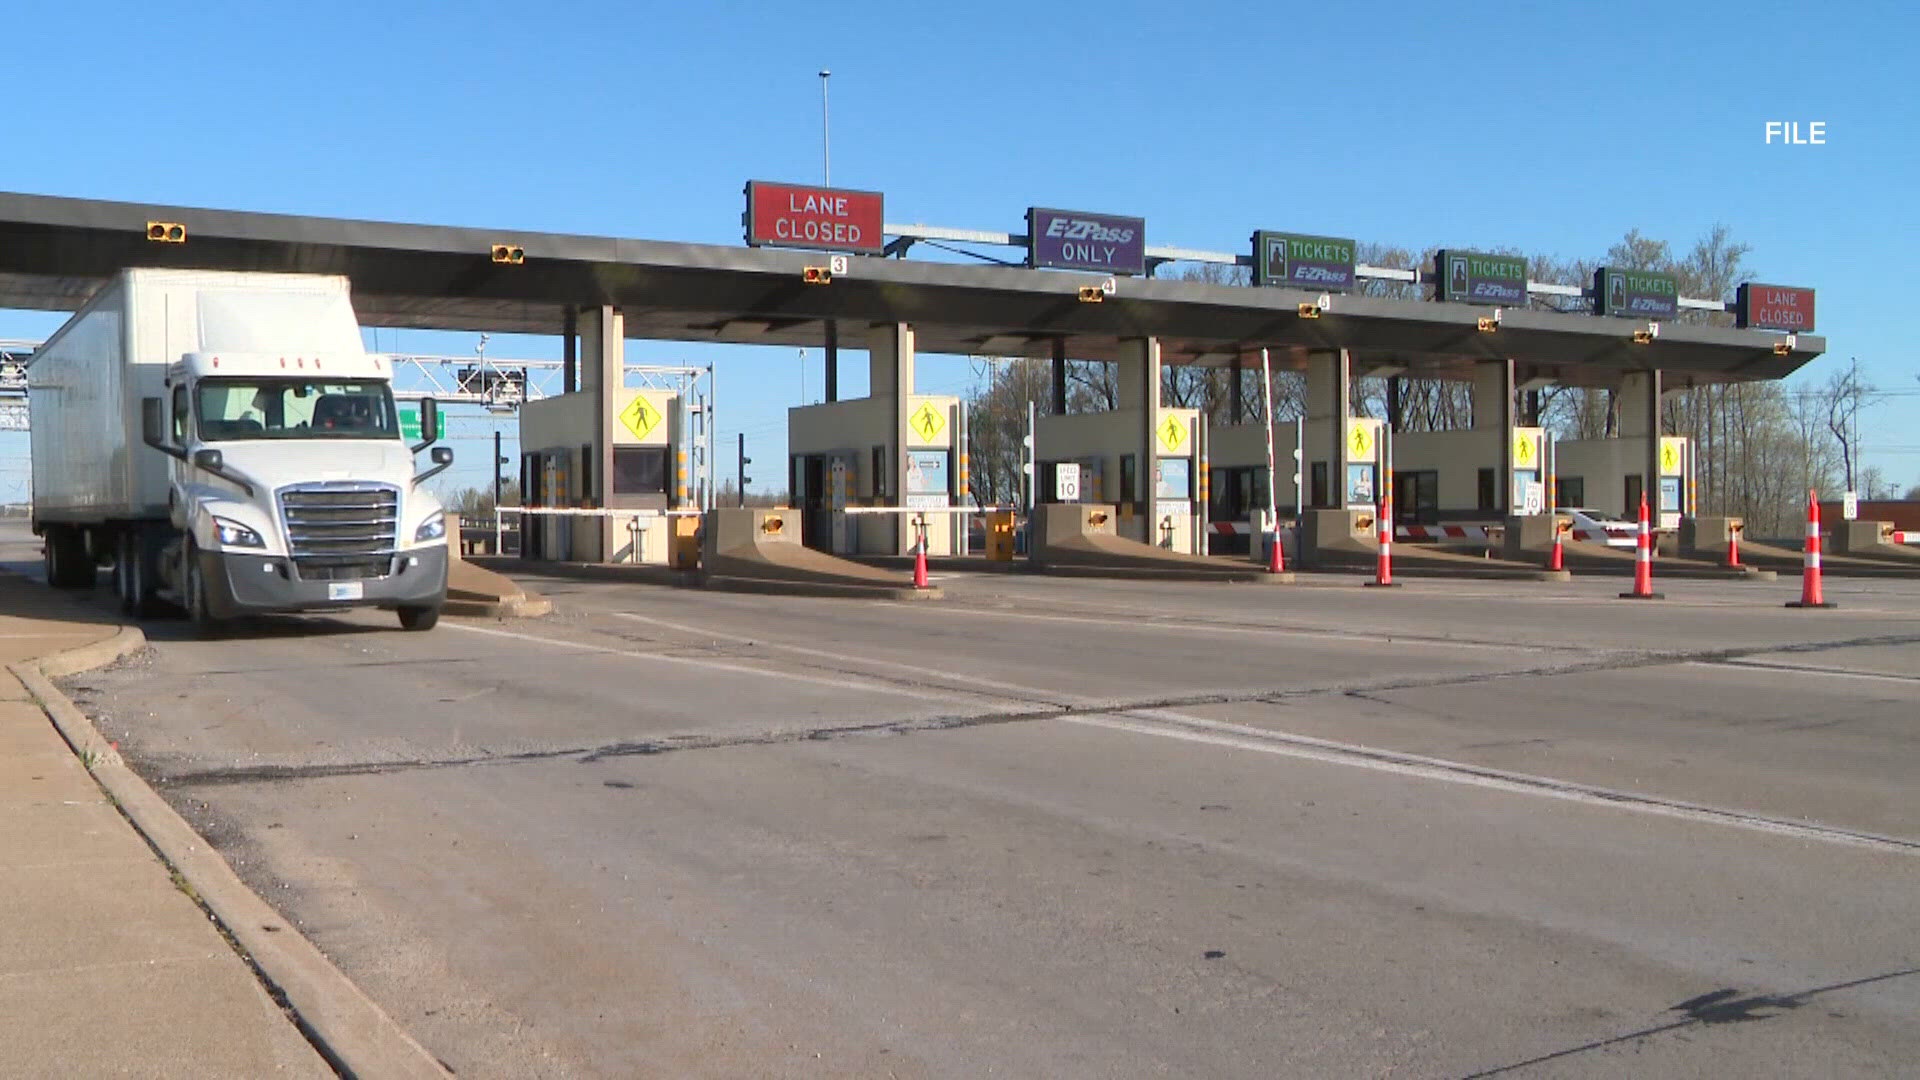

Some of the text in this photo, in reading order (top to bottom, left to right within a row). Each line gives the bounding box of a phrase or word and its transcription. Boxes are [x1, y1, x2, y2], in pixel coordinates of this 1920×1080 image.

[789, 193, 849, 217] LANE
[775, 217, 861, 243] CLOSED
[1062, 242, 1116, 264] ONLY
[1291, 241, 1350, 263] TICKETS
[834, 256, 843, 273] 3
[1472, 260, 1522, 279] TICKETS
[1104, 279, 1113, 292] 4
[1628, 277, 1674, 295] TICKETS
[1767, 291, 1797, 307] LANE
[1760, 307, 1804, 325] CLOSED
[1061, 482, 1076, 496] 10
[1527, 497, 1538, 508] 10
[1846, 506, 1855, 516] 10
